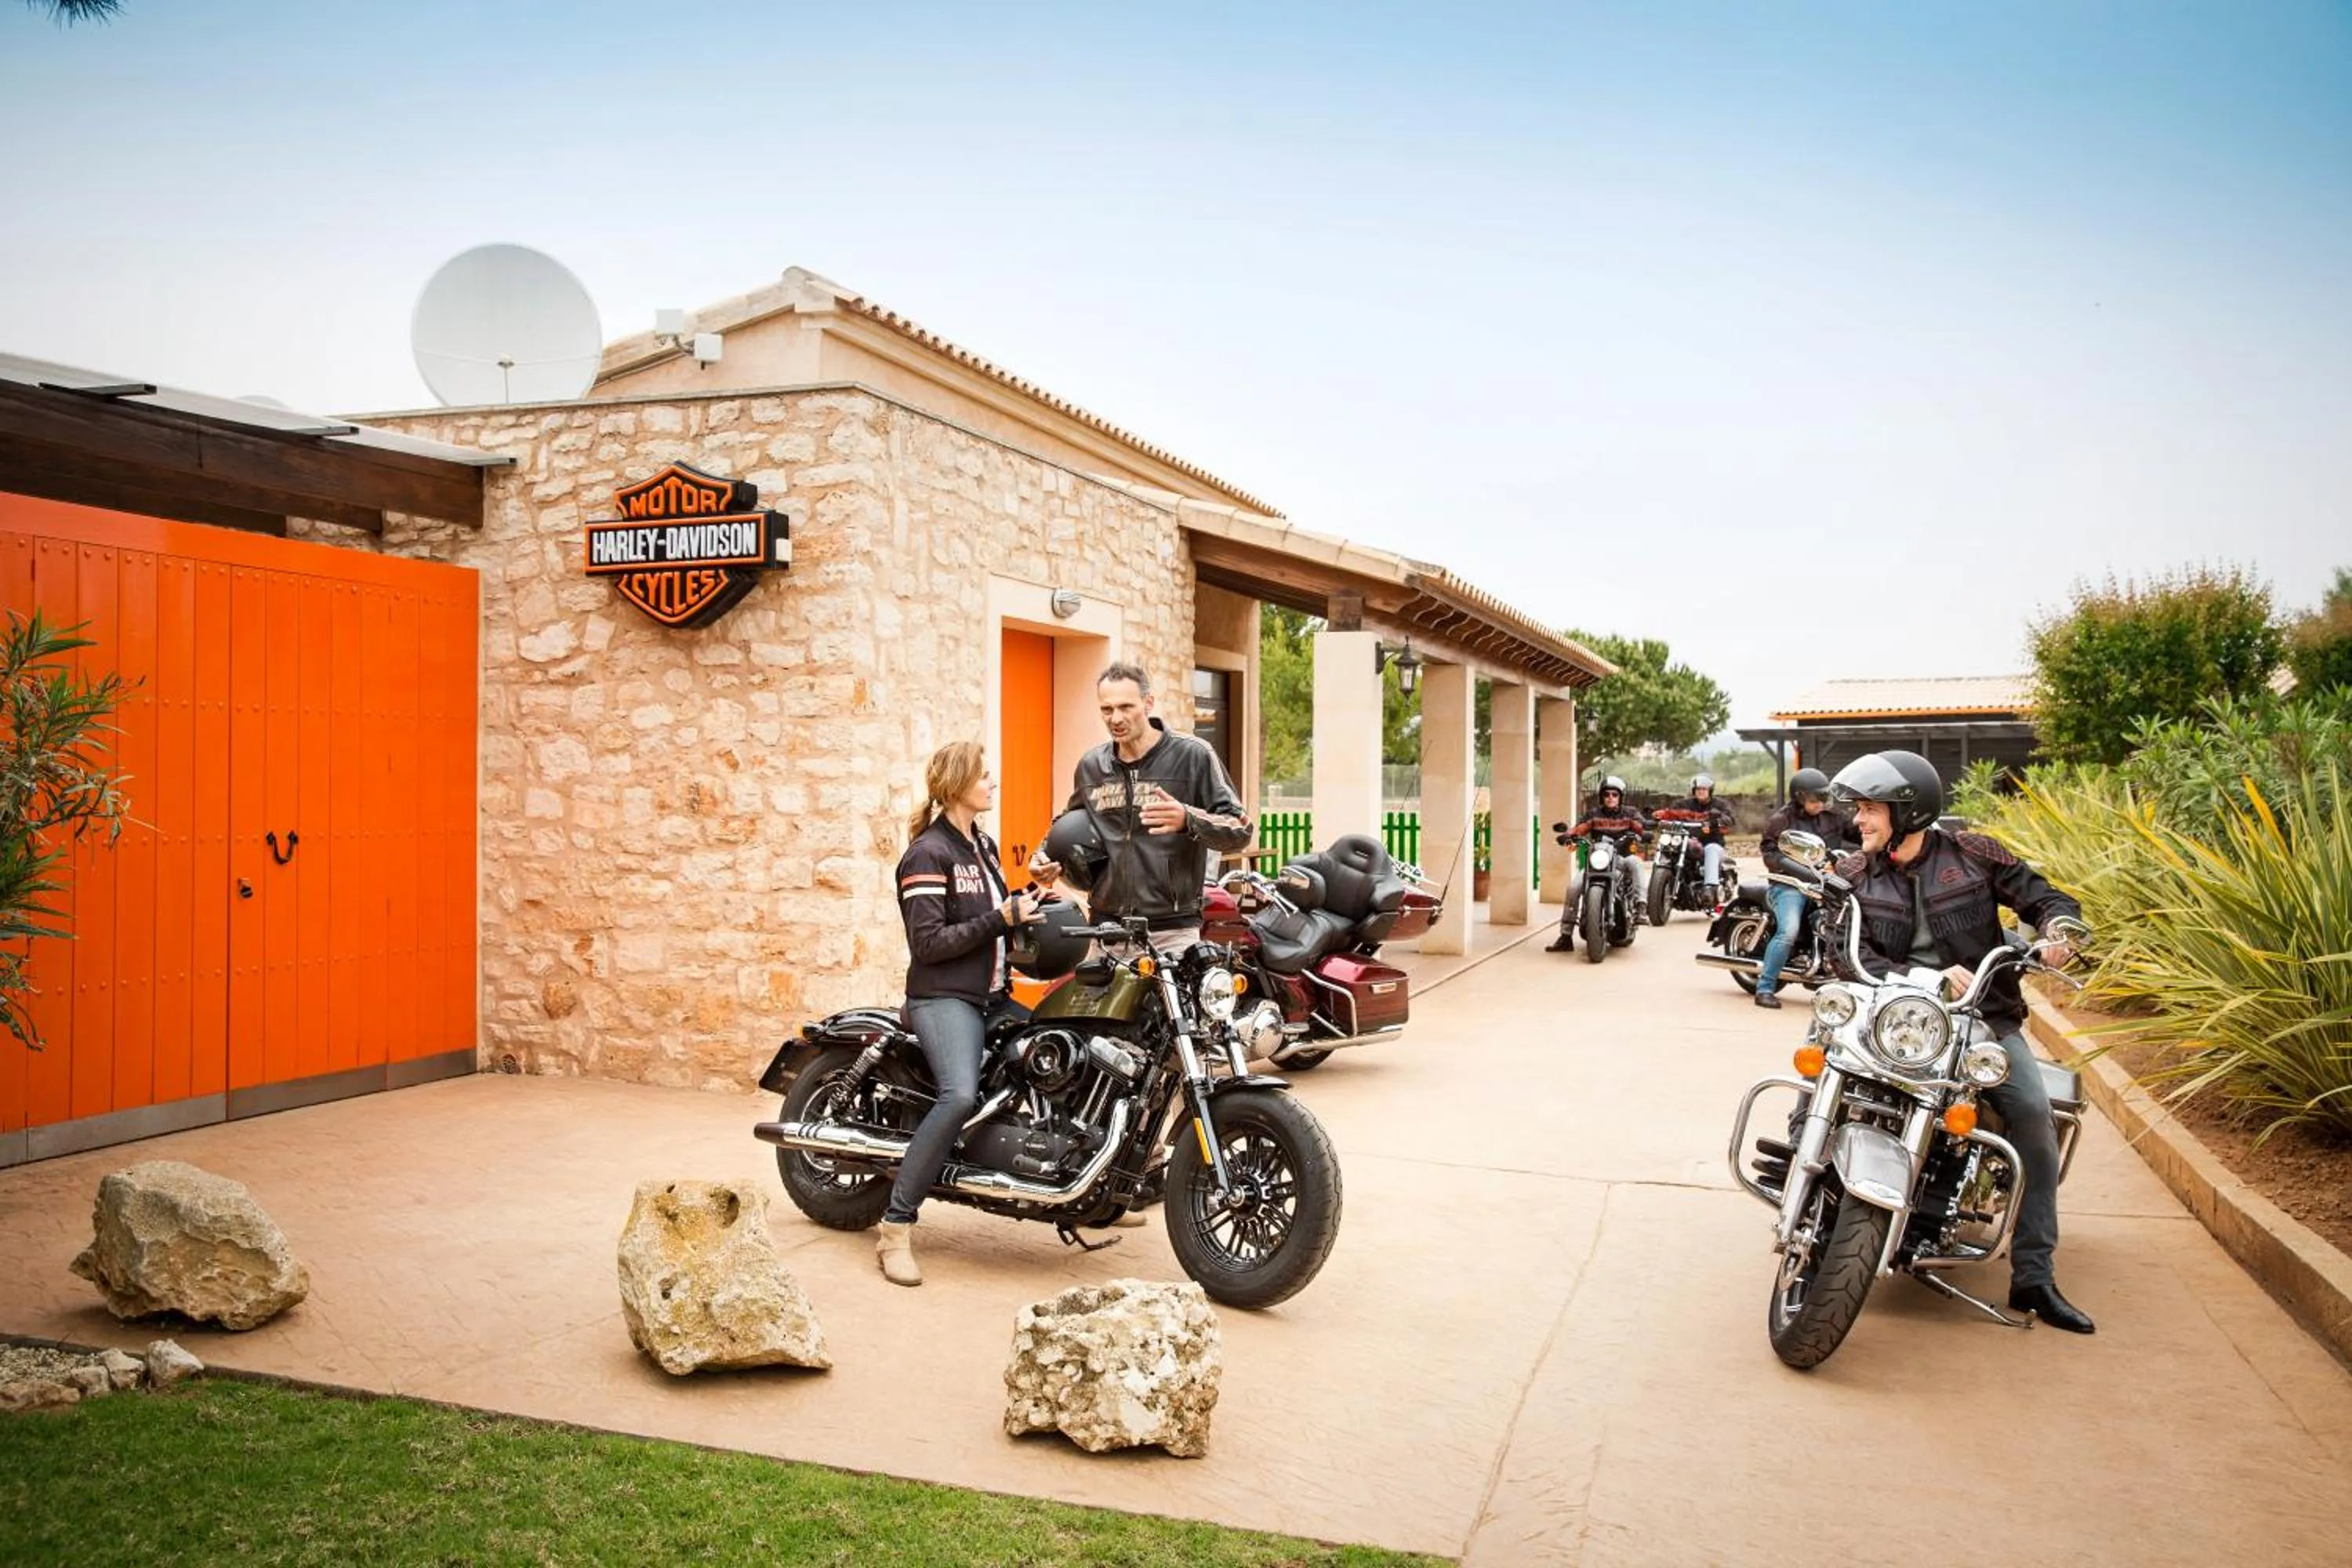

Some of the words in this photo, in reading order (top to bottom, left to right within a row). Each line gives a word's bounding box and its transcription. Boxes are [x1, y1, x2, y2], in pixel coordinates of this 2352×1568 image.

[630, 476, 718, 517] MOTOR
[593, 522, 757, 564] HARLEY-DAVIDSON
[632, 570, 716, 615] CYCLES
